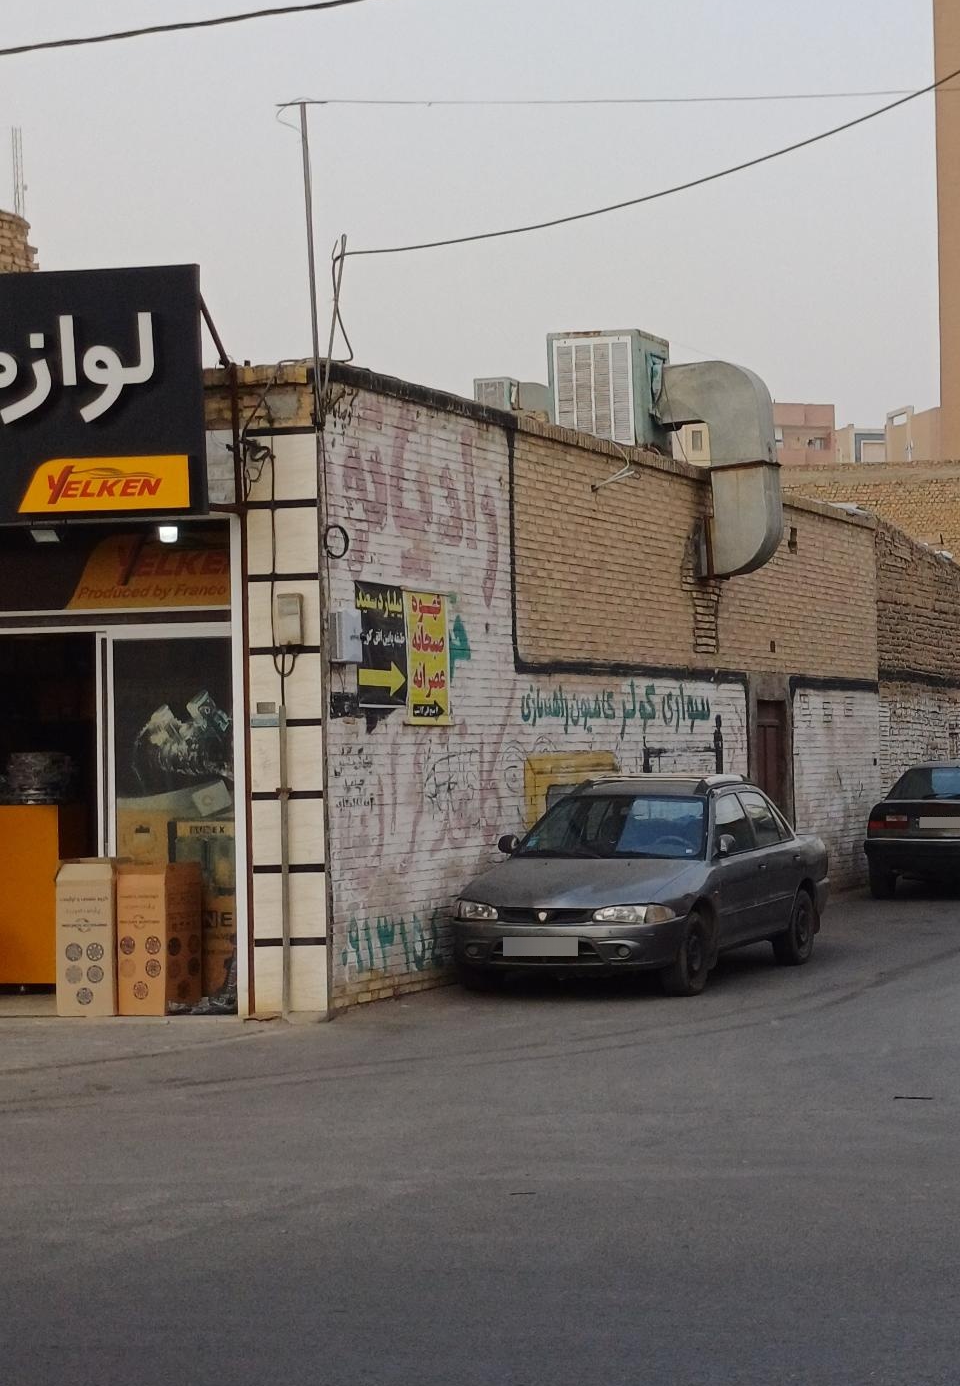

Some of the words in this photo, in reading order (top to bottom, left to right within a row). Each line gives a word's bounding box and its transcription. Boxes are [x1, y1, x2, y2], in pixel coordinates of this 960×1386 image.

[47, 465, 162, 504] YELKEN
[114, 533, 230, 587] YELKE
[78, 586, 150, 600] Produced
[153, 585, 172, 600] by
[411, 595, 442, 622] قهوه
[411, 623, 446, 660] صبحانه
[413, 663, 446, 698] عصرانه
[662, 683, 711, 734] سواری
